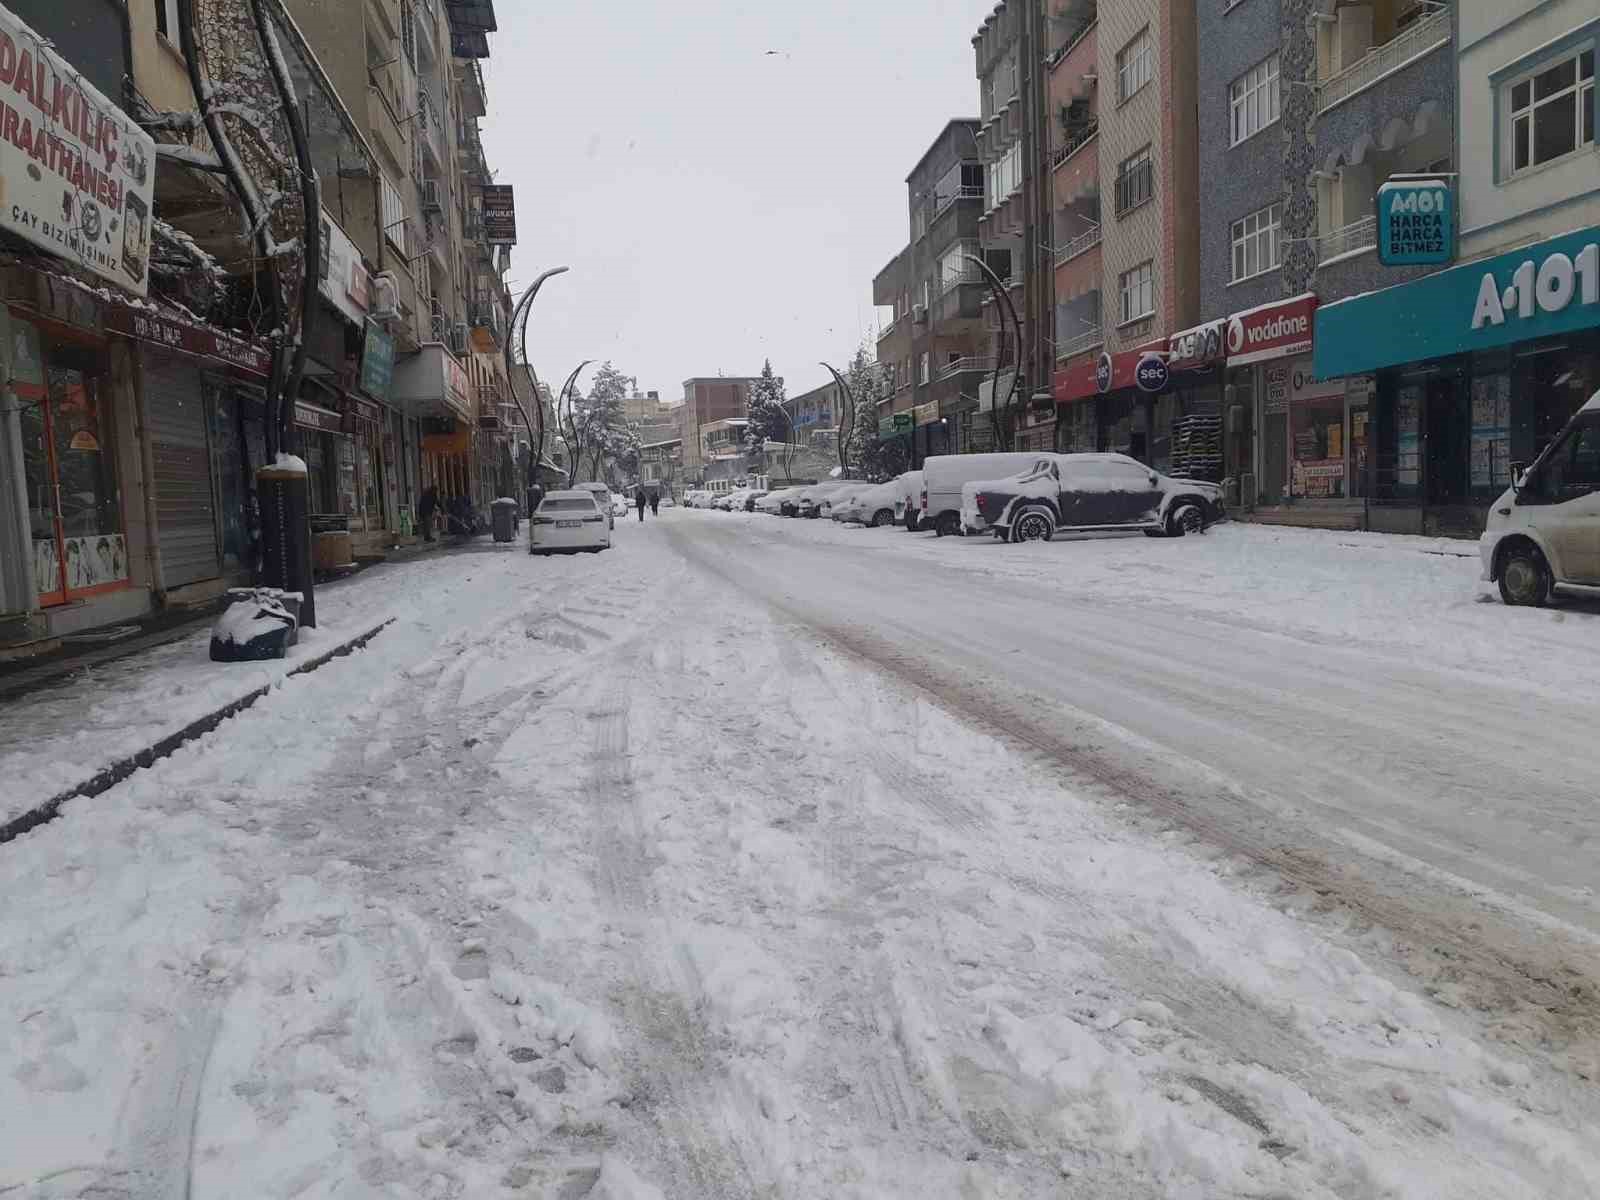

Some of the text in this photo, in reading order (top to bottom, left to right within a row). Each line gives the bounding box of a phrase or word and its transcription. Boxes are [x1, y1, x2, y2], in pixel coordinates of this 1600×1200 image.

[12, 205, 38, 228] ÇAY
[1390, 214, 1443, 227] HARCA
[1390, 227, 1443, 240] HARCA
[1247, 314, 1308, 344] vodafone
